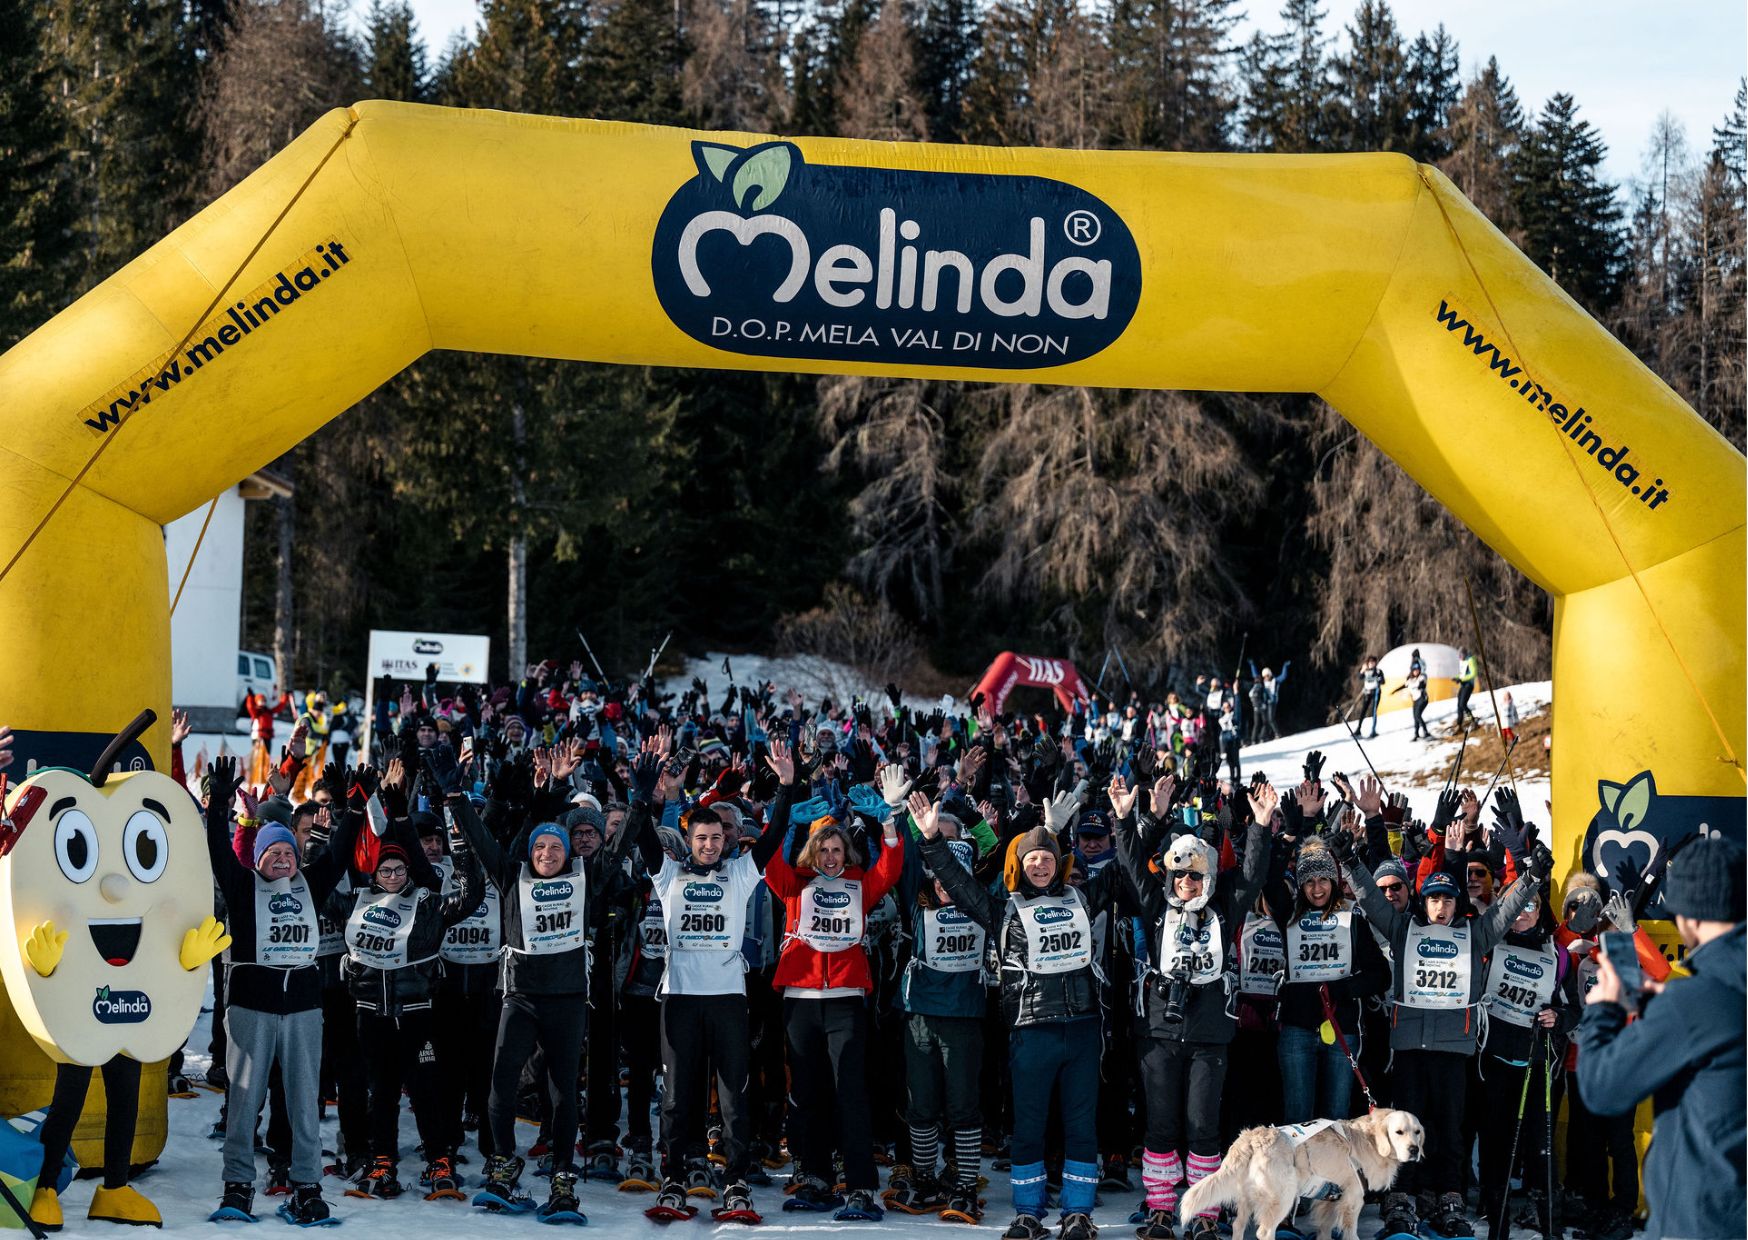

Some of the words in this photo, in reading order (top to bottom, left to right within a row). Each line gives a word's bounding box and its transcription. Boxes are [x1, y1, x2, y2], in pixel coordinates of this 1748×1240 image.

[678, 207, 1113, 320] Melinda
[85, 240, 350, 434] www.melinda.it
[711, 315, 793, 343] D.O.P.
[799, 322, 880, 347] MELA
[890, 327, 944, 350] VAL
[952, 331, 981, 352] DI
[991, 333, 1070, 356] NON
[1436, 299, 1670, 510] www.melinda.it
[395, 659, 418, 669] ITAS
[1028, 656, 1065, 684] ITAS
[533, 884, 572, 897] Melinda
[684, 887, 722, 897] Melinda
[814, 894, 849, 904] Melinda
[364, 910, 400, 925] Melinda
[535, 911, 572, 933] 3147
[680, 913, 725, 932] 2560
[1035, 910, 1073, 920] Melinda
[269, 924, 309, 943] 3207
[811, 916, 851, 934] 2901
[355, 931, 396, 952] 2760
[447, 927, 490, 945] 3094
[936, 934, 976, 954] 2902
[1039, 931, 1082, 954] 2502
[1299, 942, 1340, 962] 3214
[1418, 943, 1457, 954] Melinda
[1505, 960, 1542, 976] Melinda
[1416, 969, 1458, 989] 3212
[1497, 982, 1537, 1008] 2473
[95, 997, 148, 1014] Melinda
